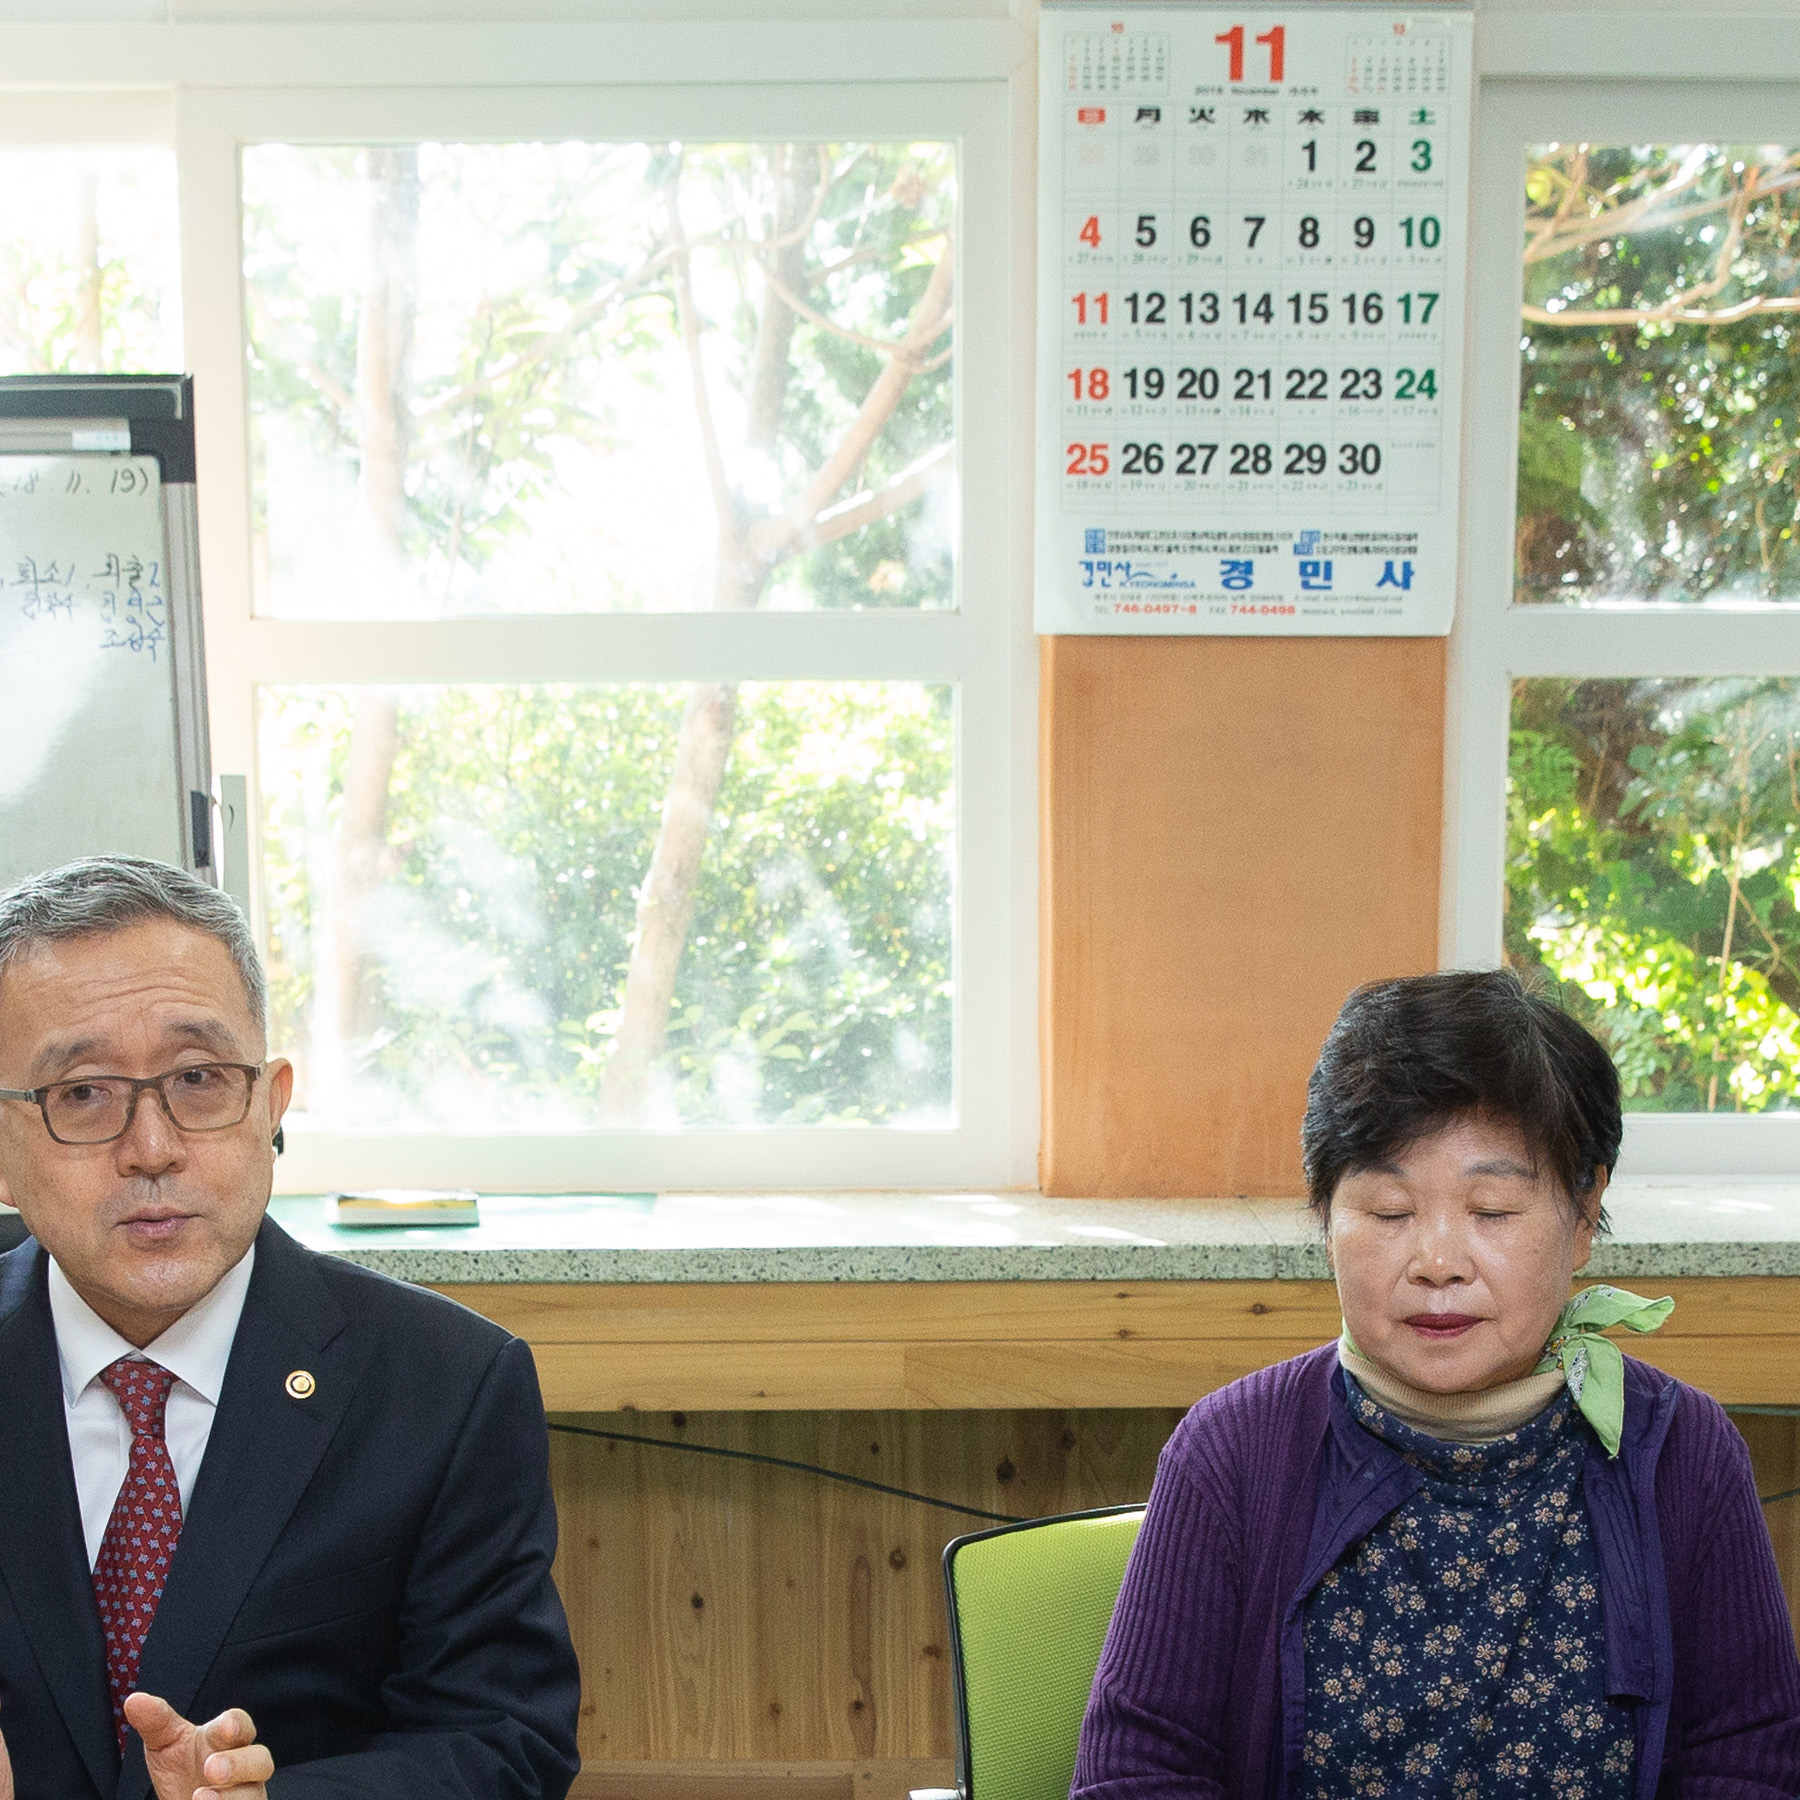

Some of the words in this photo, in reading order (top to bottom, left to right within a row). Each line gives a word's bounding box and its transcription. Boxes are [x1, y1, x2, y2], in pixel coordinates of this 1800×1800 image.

[1214, 24, 1286, 83] 11
[1134, 106, 1162, 124] 月
[1189, 106, 1215, 124] 火
[1244, 107, 1270, 125] 水
[1298, 107, 1325, 125] 木
[1410, 106, 1434, 125] 土
[1301, 138, 1317, 173] 1
[1354, 138, 1378, 174] 2
[1410, 137, 1433, 174] 3
[1079, 215, 1102, 249] 4
[1135, 213, 1158, 249] 5
[1189, 214, 1212, 250] 6
[1243, 214, 1267, 249] 7
[1297, 214, 1321, 250] 8
[1353, 214, 1376, 250] 9
[1398, 214, 1443, 250] 10
[1071, 291, 1109, 325] 11
[1124, 290, 1167, 325] 12
[1178, 290, 1221, 326] 13
[1232, 291, 1275, 325] 14
[1286, 291, 1330, 326] 15
[1341, 290, 1385, 326] 16
[1395, 291, 1441, 325] 17
[1067, 367, 1110, 401] 18
[1122, 365, 1167, 401] 19
[1176, 366, 1221, 401] 20
[1233, 367, 1272, 401] 21
[1284, 367, 1330, 401] 22
[1339, 366, 1384, 401] 23
[1394, 366, 1440, 401] 24
[1066, 442, 1110, 476] 25
[1121, 441, 1165, 476] 26
[1175, 441, 1220, 476] 27
[1229, 442, 1273, 476] 28
[1283, 442, 1328, 476] 29
[1337, 442, 1383, 477] 30
